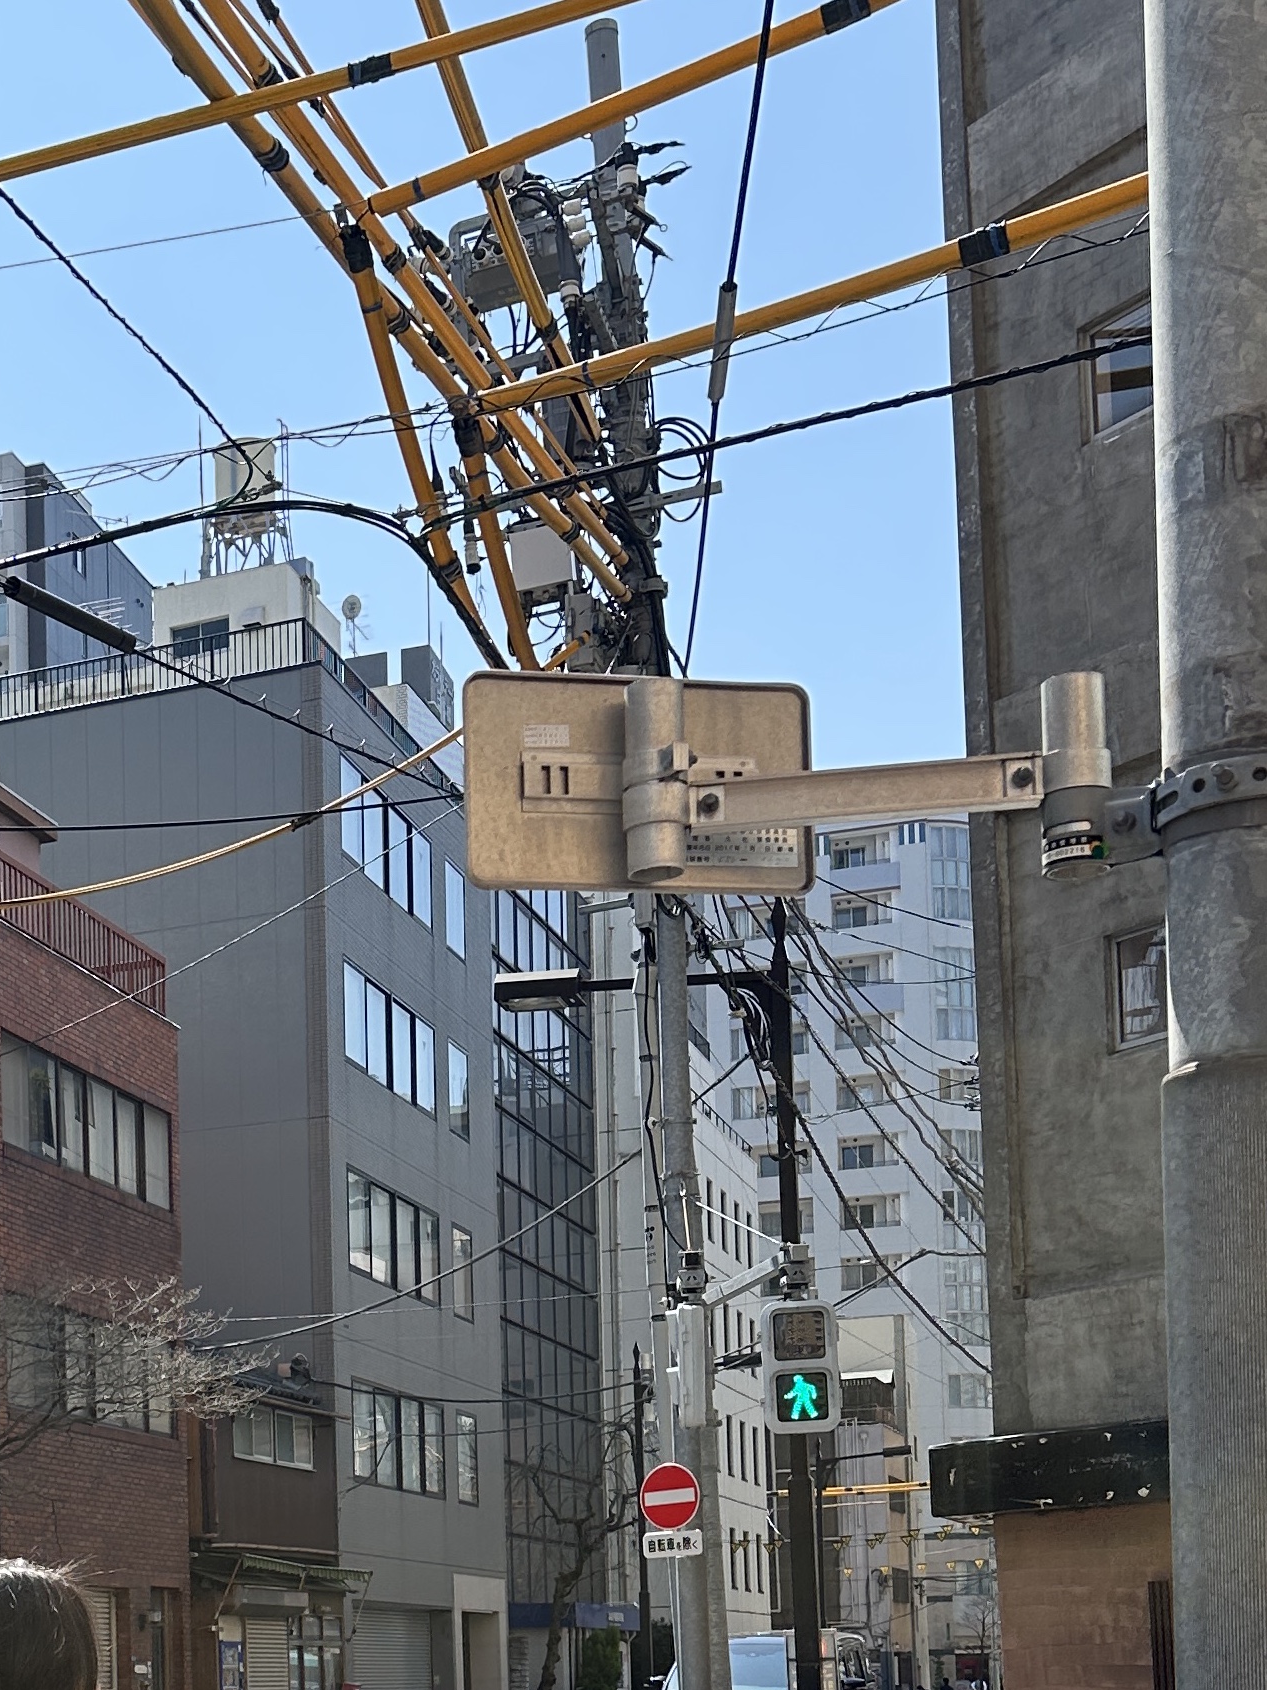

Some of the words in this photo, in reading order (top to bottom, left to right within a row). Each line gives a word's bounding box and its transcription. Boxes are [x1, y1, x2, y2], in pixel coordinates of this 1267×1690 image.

[647, 1536, 698, 1553] 自転車を除く
